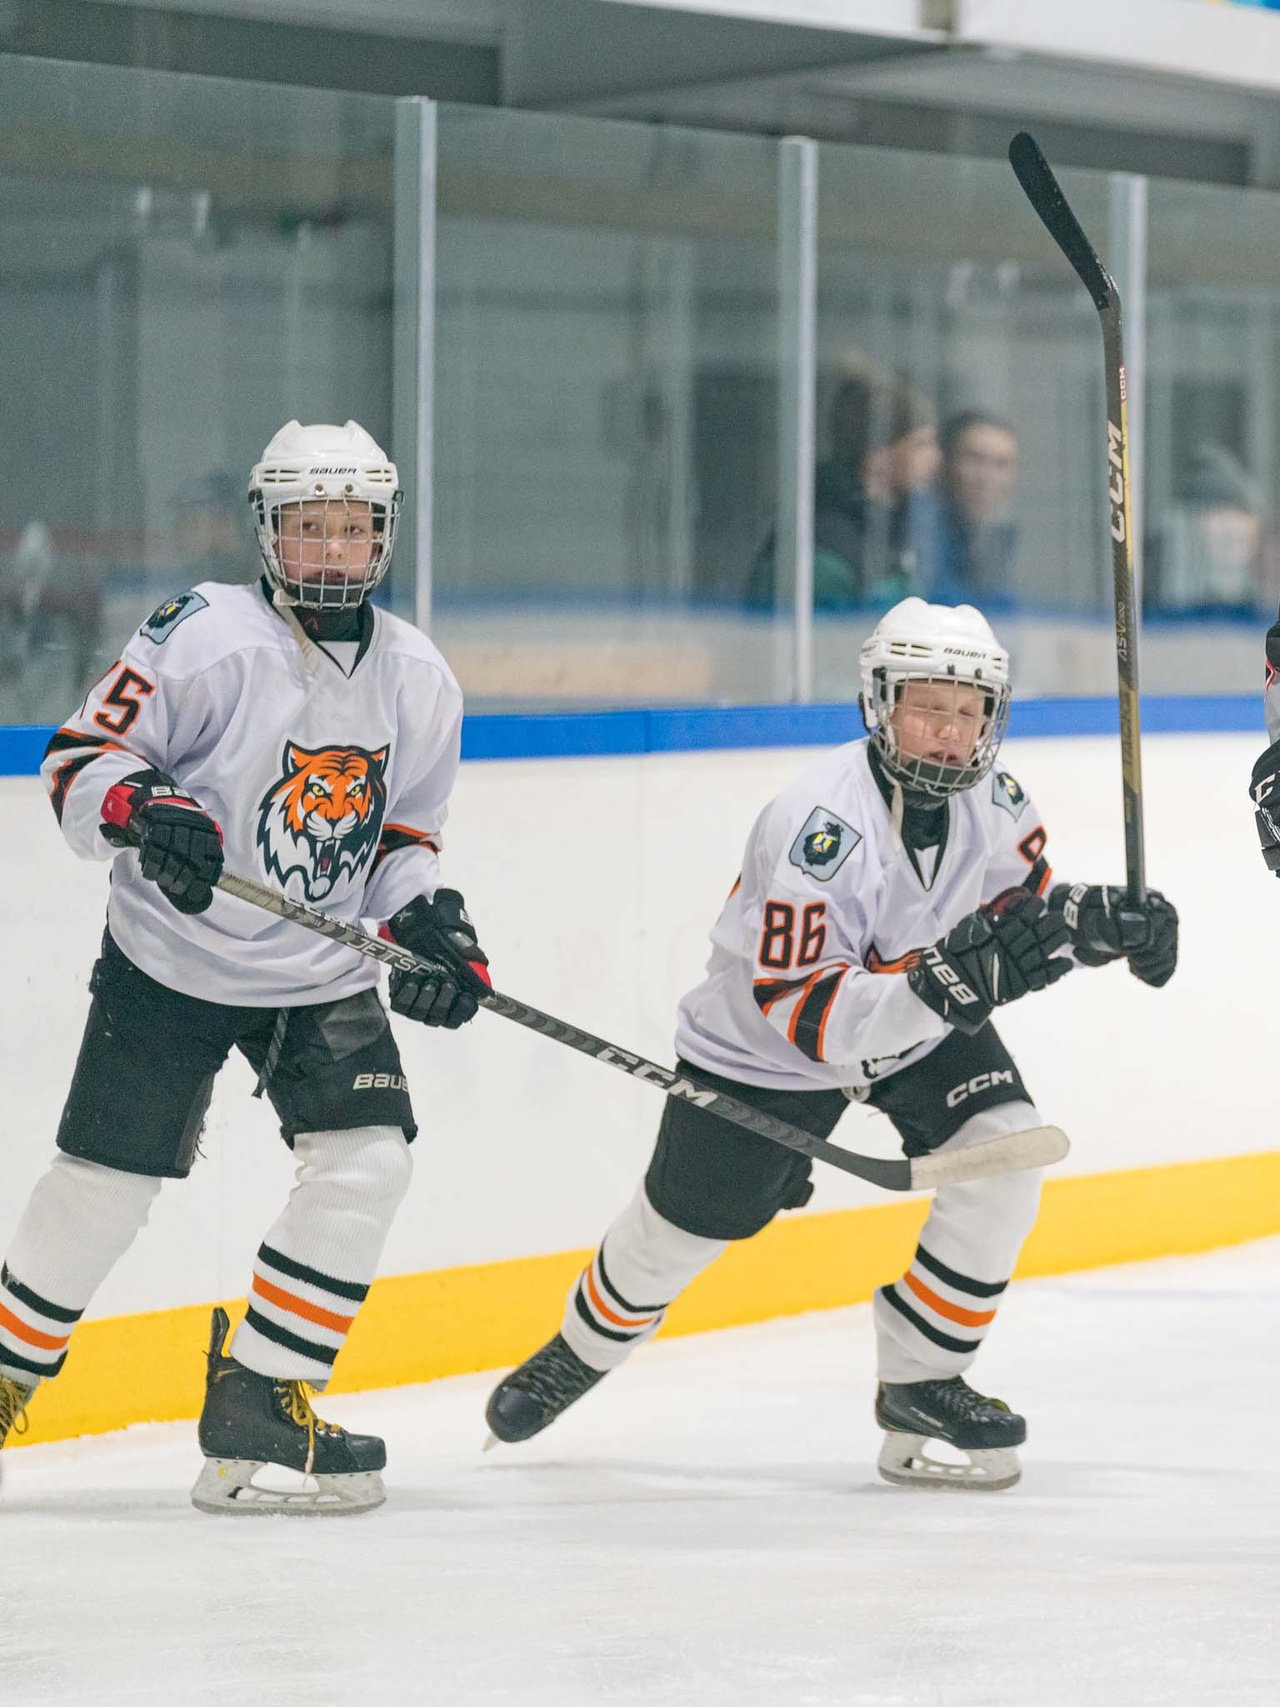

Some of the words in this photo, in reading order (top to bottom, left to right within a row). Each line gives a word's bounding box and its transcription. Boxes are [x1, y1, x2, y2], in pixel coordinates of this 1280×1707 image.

[1107, 419, 1125, 544] CCM
[79, 659, 156, 737] 5
[758, 899, 827, 970] 86
[596, 1045, 719, 1108] CCM
[946, 1069, 1013, 1108] CCM
